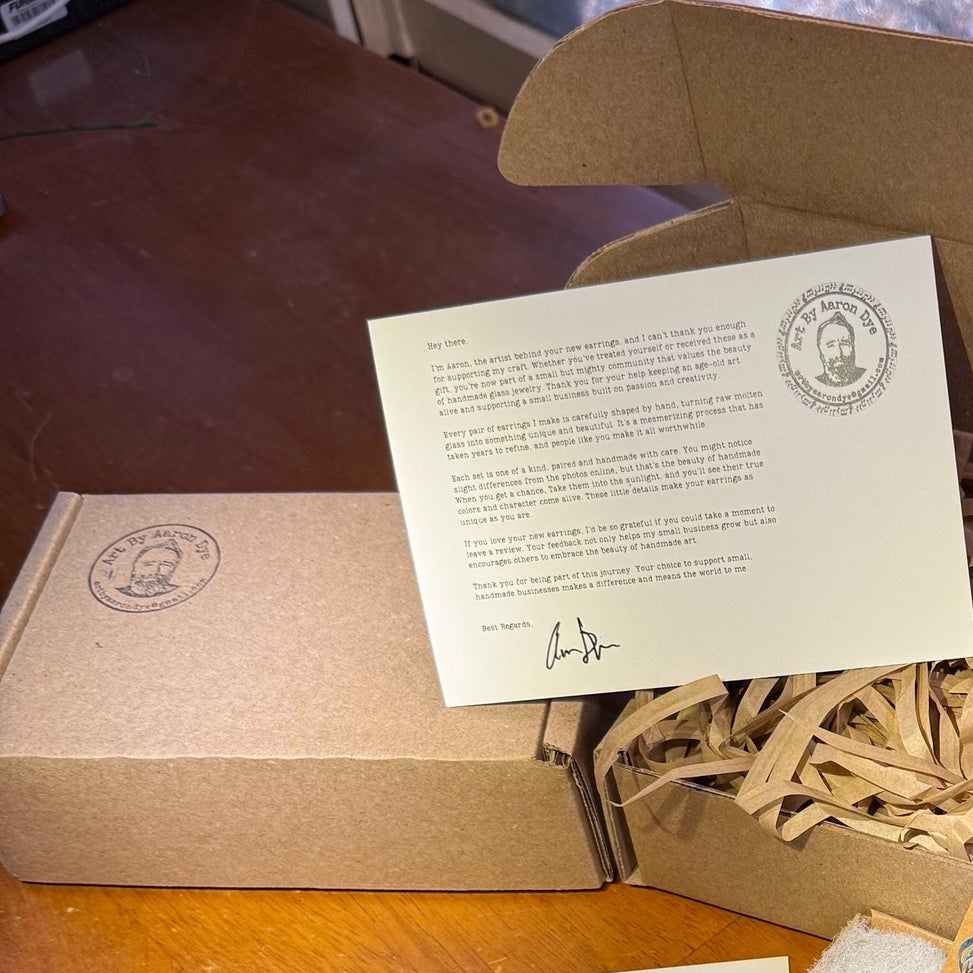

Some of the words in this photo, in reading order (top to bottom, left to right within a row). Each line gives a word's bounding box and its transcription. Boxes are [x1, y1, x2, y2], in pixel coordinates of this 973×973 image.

[488, 354, 512, 362] artist
[513, 349, 542, 359] behind
[543, 348, 564, 357] your
[624, 336, 640, 344] and
[647, 332, 668, 340] can't
[670, 328, 696, 337] thank
[696, 327, 713, 336] you
[715, 321, 746, 331] enough
[790, 325, 805, 351] Art
[801, 308, 817, 325] By
[820, 300, 858, 315] Aaron
[859, 309, 877, 336] Dye
[446, 369, 491, 381] supporting
[491, 367, 506, 375] my
[530, 359, 566, 368] Whether
[567, 355, 596, 365] you've
[595, 349, 625, 359] treated
[627, 344, 663, 357] yourself
[676, 337, 711, 348] received
[712, 335, 736, 343] these
[453, 382, 479, 393] you're
[498, 376, 516, 386] part
[534, 370, 558, 379] small
[559, 368, 574, 376] but
[575, 364, 606, 374] mighty
[607, 358, 657, 369] community
[656, 354, 675, 363] that
[677, 352, 705, 360] values
[722, 344, 752, 354] beauty
[446, 392, 488, 403] handmade
[488, 390, 510, 399] glass
[545, 380, 572, 389] Thank
[573, 379, 589, 388] you
[604, 374, 626, 384] your
[627, 371, 647, 379] help
[647, 367, 680, 376] keeping
[694, 360, 725, 371] age-old
[727, 357, 740, 365] art
[476, 400, 521, 411] supporting
[528, 395, 552, 403] small
[553, 391, 589, 400] business
[591, 387, 611, 395] built
[626, 382, 657, 392] passion
[659, 378, 674, 386] and
[459, 518, 488, 526] unique
[499, 514, 515, 522] you
[102, 545, 126, 566] Art
[127, 534, 147, 546] By
[153, 530, 197, 543] Aaron
[195, 540, 211, 561] Dye
[472, 581, 498, 589] Thank
[553, 573, 570, 583] part
[692, 556, 725, 566] support
[726, 553, 752, 561] small,
[475, 591, 515, 600] handmade
[516, 587, 560, 595] businesses
[595, 578, 636, 587] difference
[697, 568, 722, 576] world
